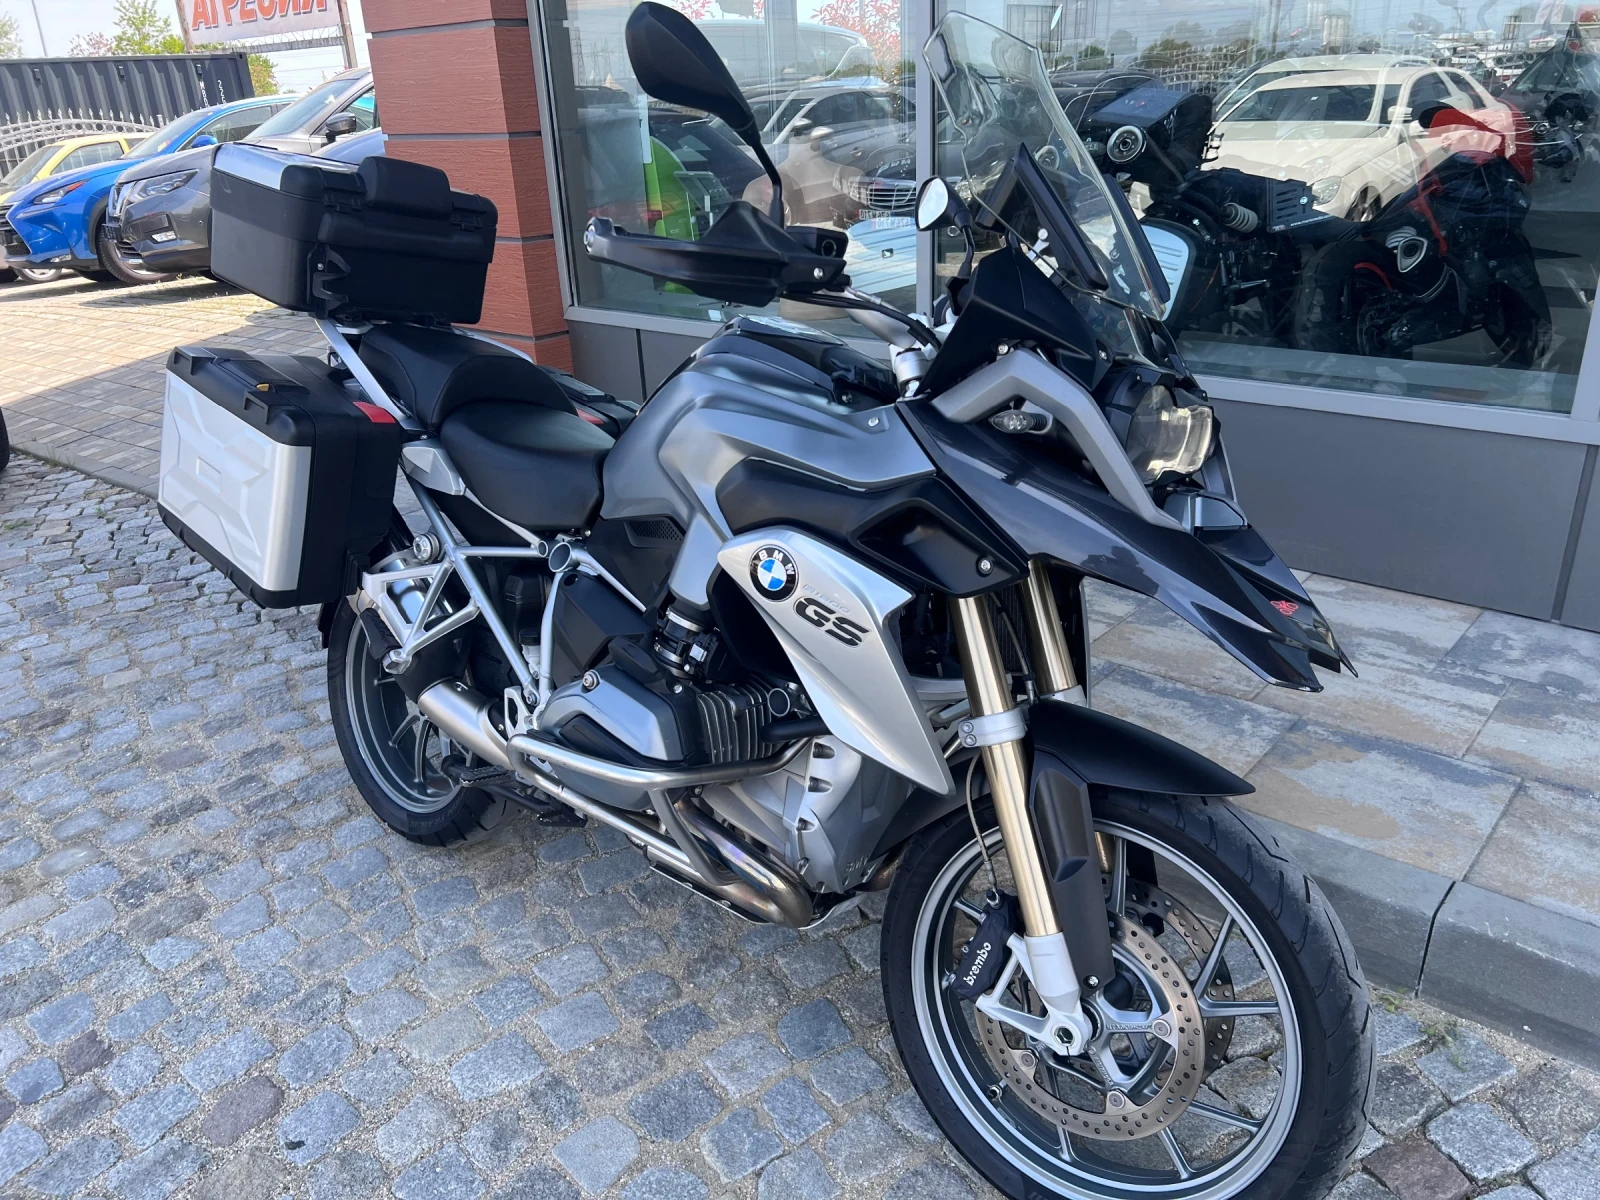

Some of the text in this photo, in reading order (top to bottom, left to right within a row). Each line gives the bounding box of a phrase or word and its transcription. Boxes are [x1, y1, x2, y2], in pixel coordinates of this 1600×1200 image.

[758, 549, 795, 575] BMW
[795, 597, 870, 647] GS
[962, 942, 992, 987] brembo
